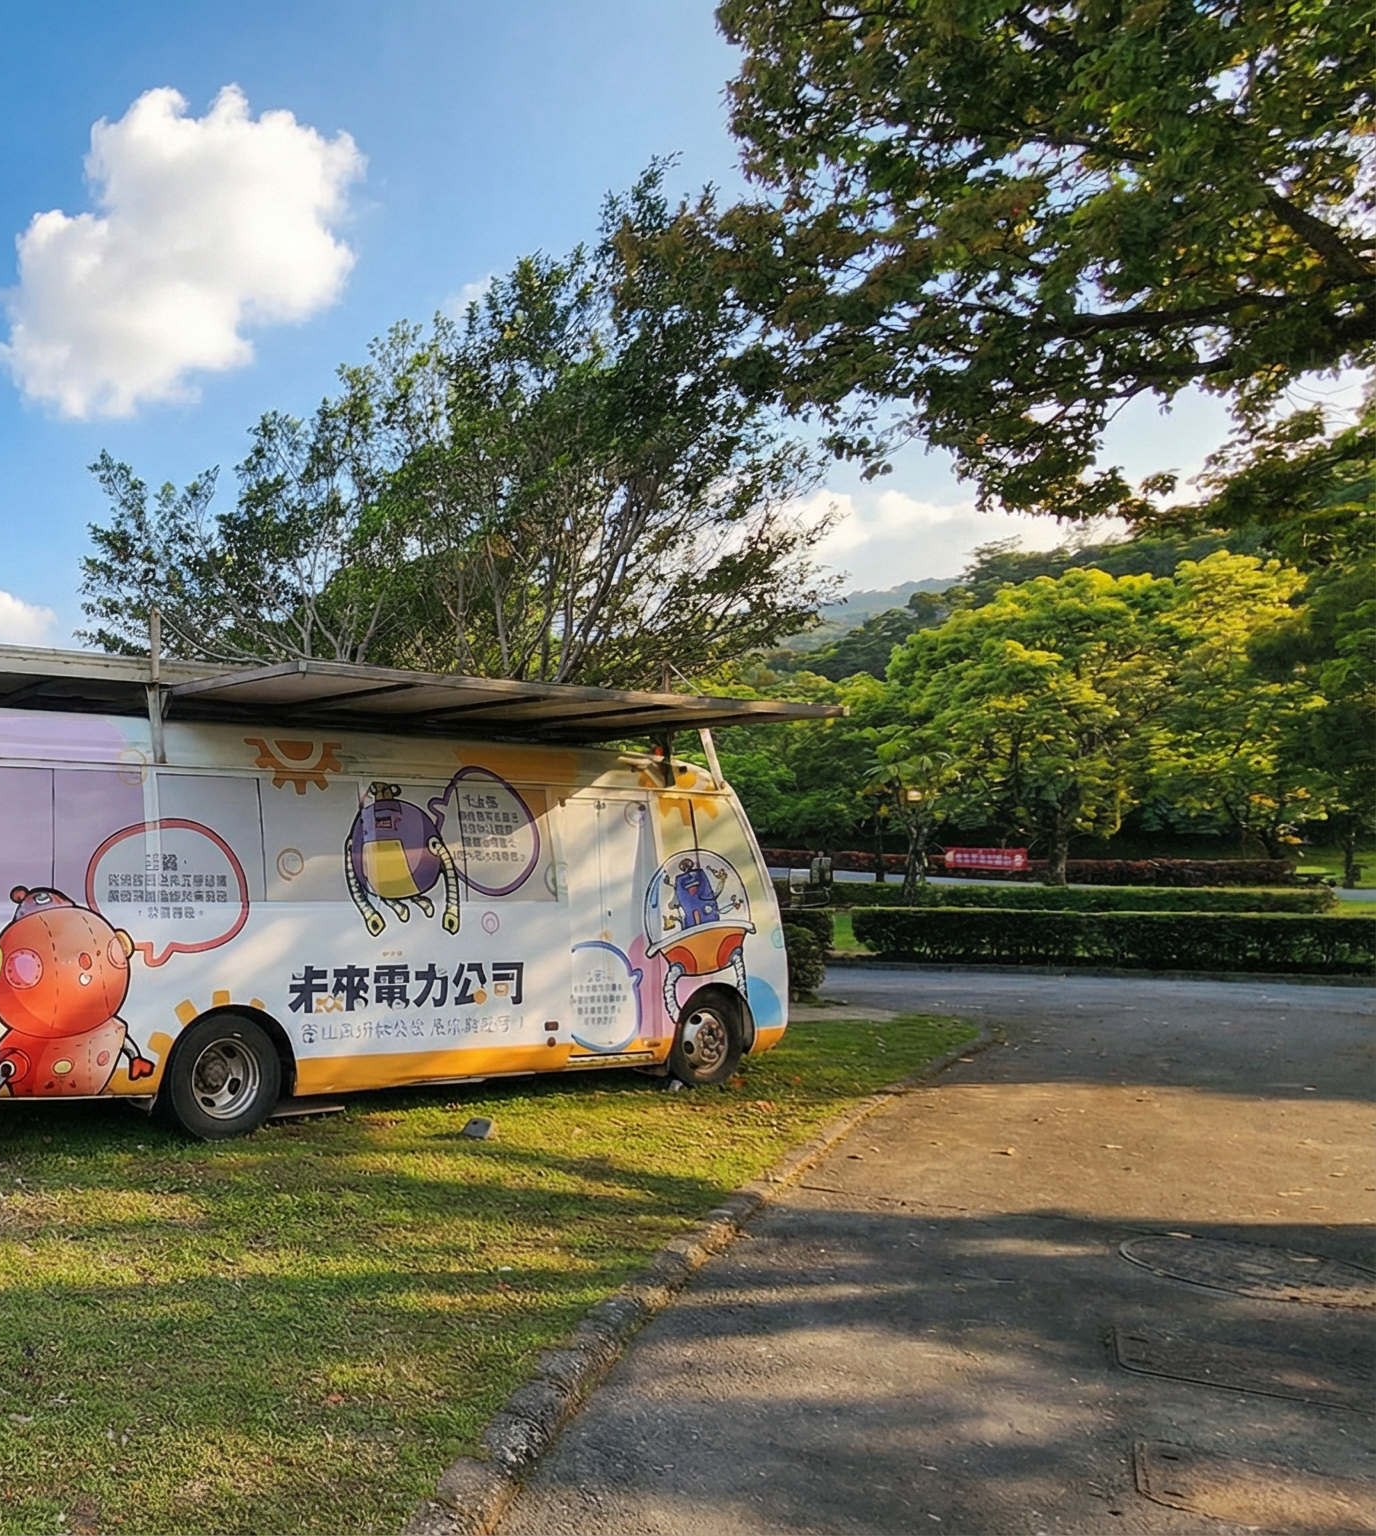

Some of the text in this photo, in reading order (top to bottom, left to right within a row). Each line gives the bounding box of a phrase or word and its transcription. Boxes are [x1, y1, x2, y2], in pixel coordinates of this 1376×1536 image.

[288, 962, 525, 1013] 未來電力公司
